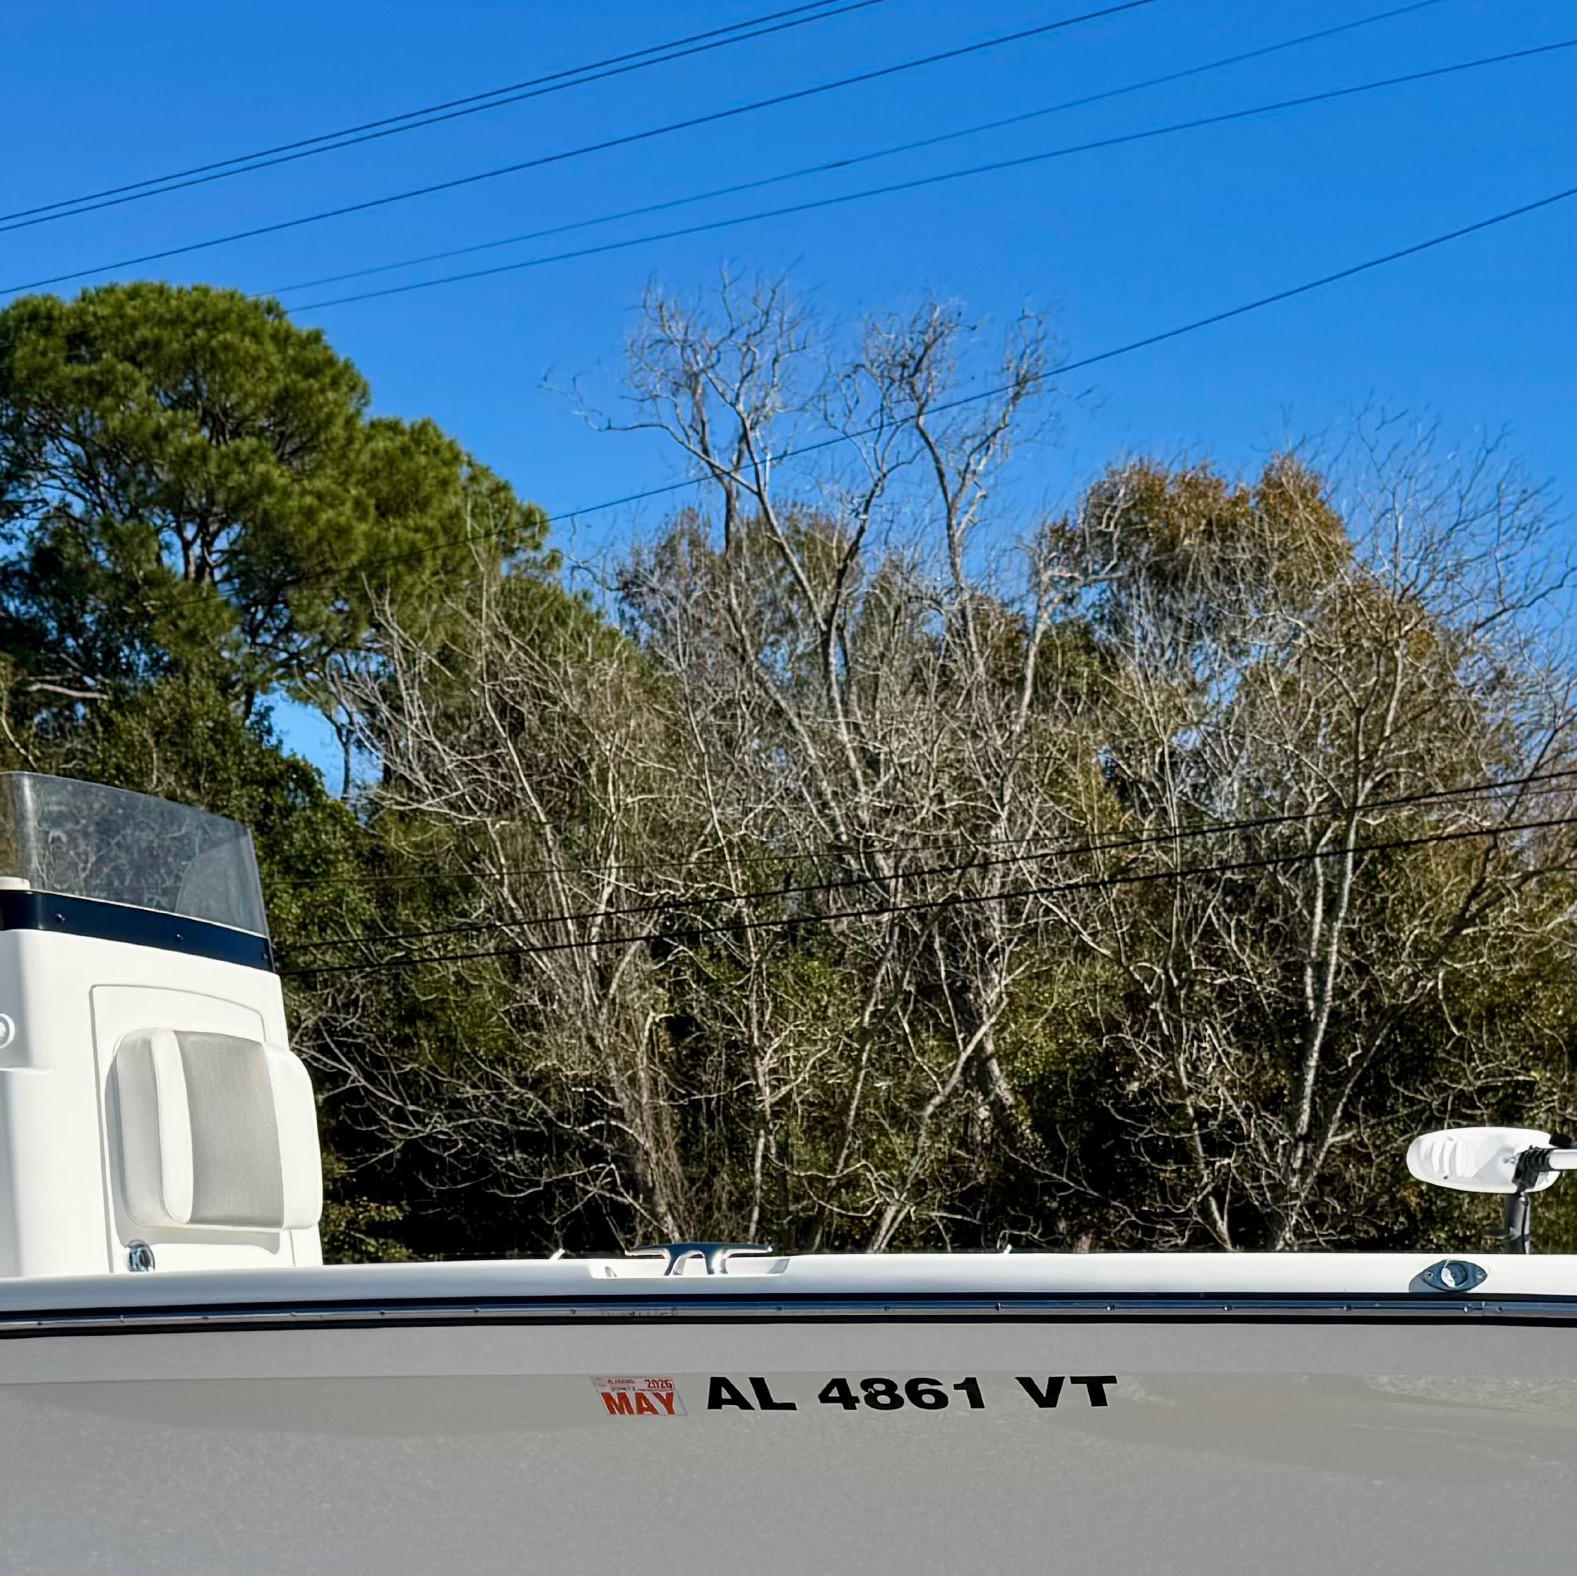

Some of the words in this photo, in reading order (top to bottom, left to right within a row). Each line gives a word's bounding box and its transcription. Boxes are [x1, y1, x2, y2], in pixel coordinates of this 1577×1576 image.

[600, 1391, 675, 1416] MAY
[707, 1376, 797, 1411] AL
[817, 1377, 986, 1411] 4861
[1014, 1375, 1118, 1408] VT
